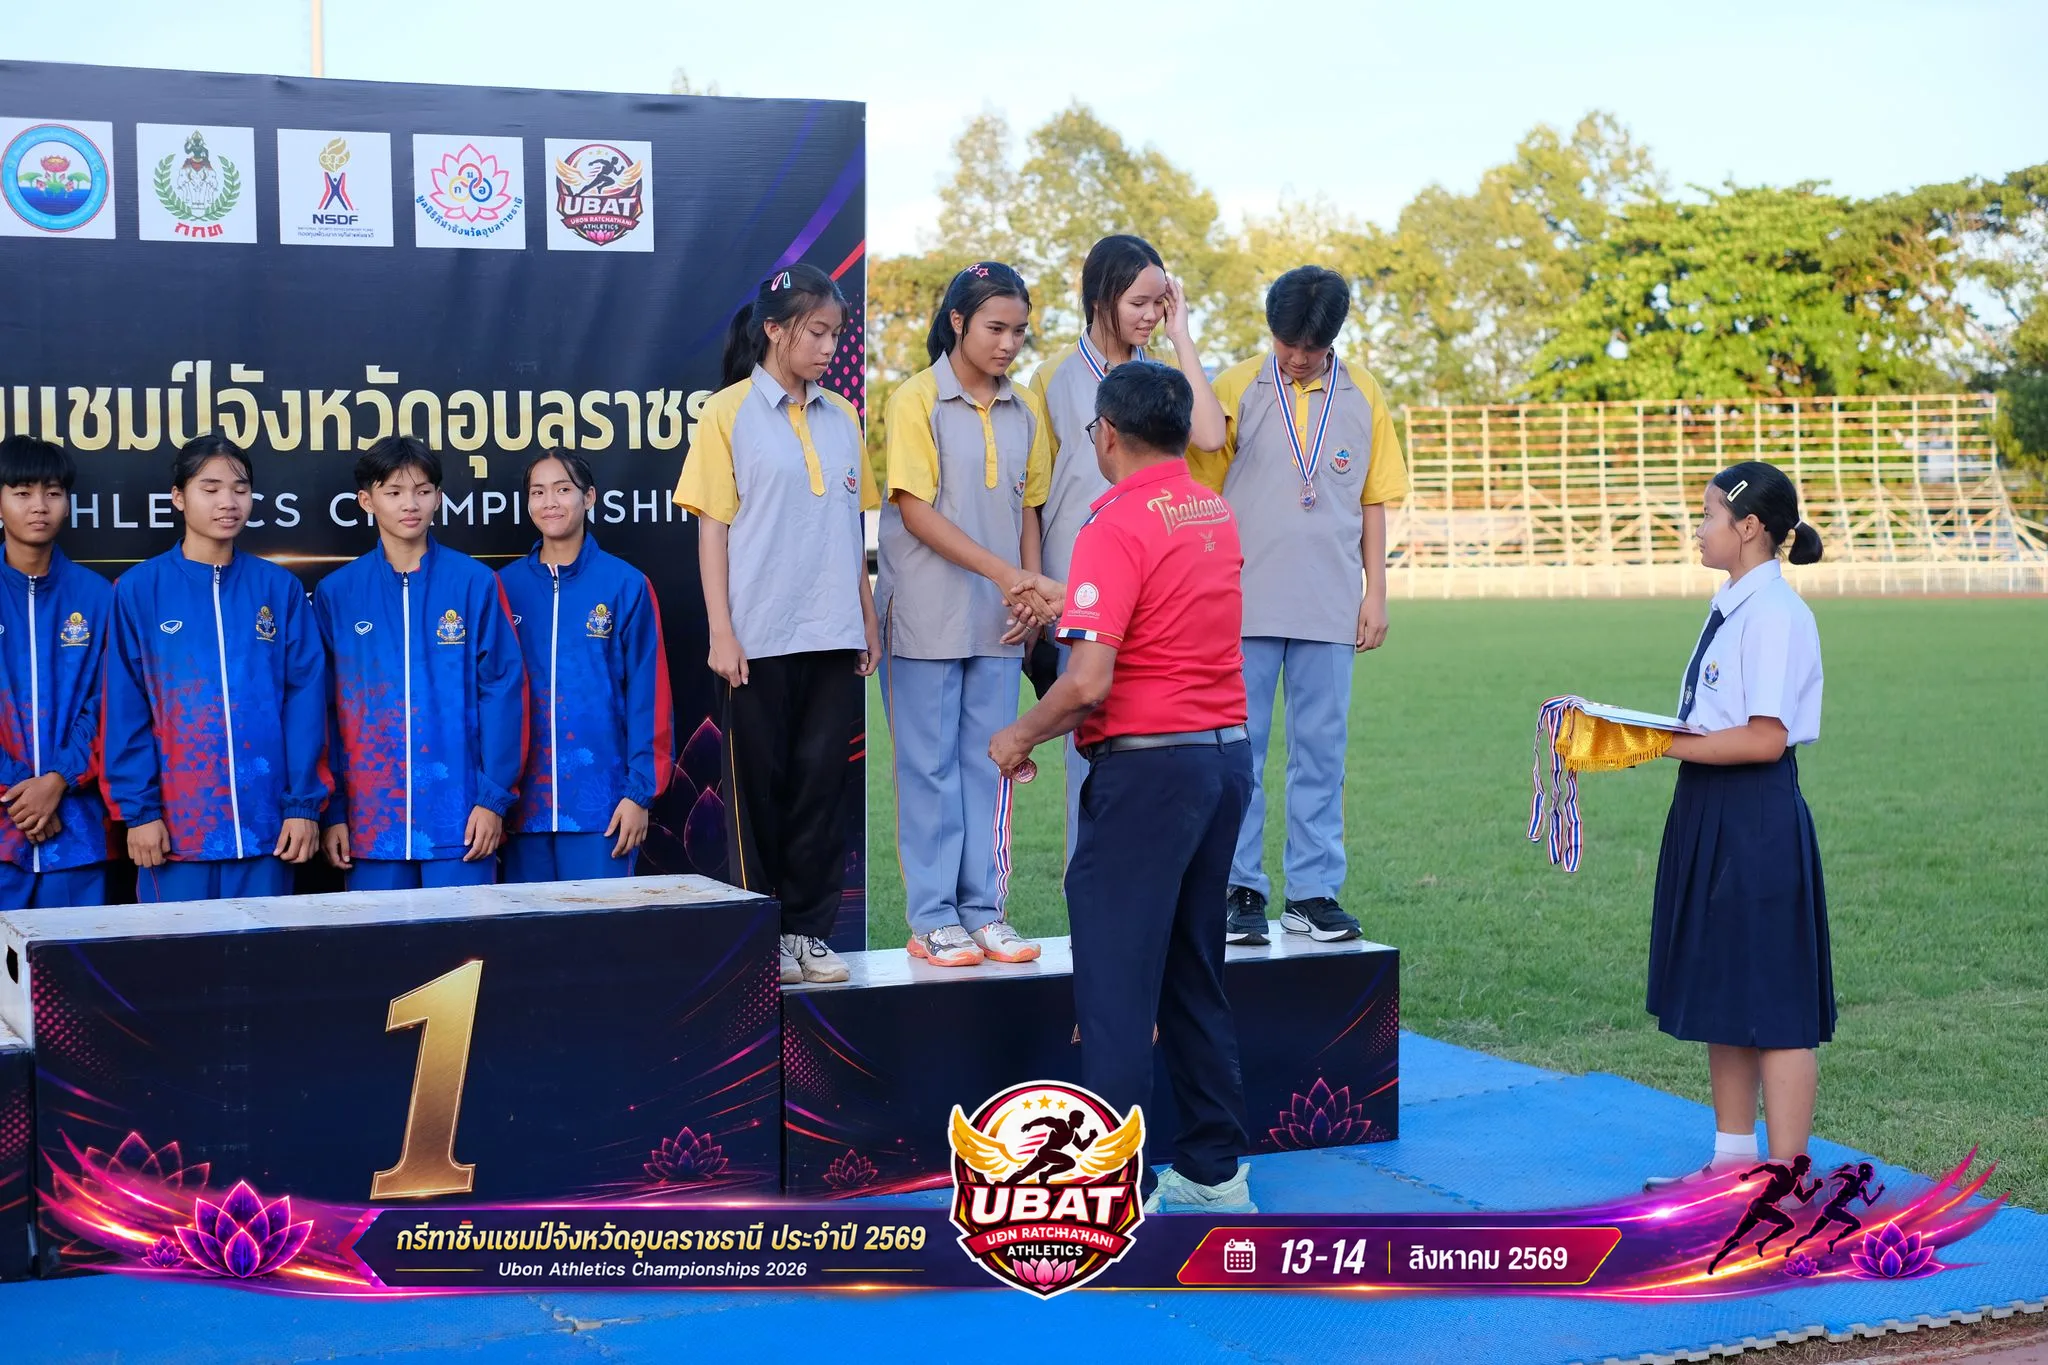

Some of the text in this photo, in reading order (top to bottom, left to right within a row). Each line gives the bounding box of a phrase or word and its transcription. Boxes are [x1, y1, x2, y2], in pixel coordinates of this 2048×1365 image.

[312, 213, 359, 225] NSDF
[563, 196, 637, 217] UBAT
[1146, 488, 1230, 537] Thailand
[370, 959, 483, 1200] 1
